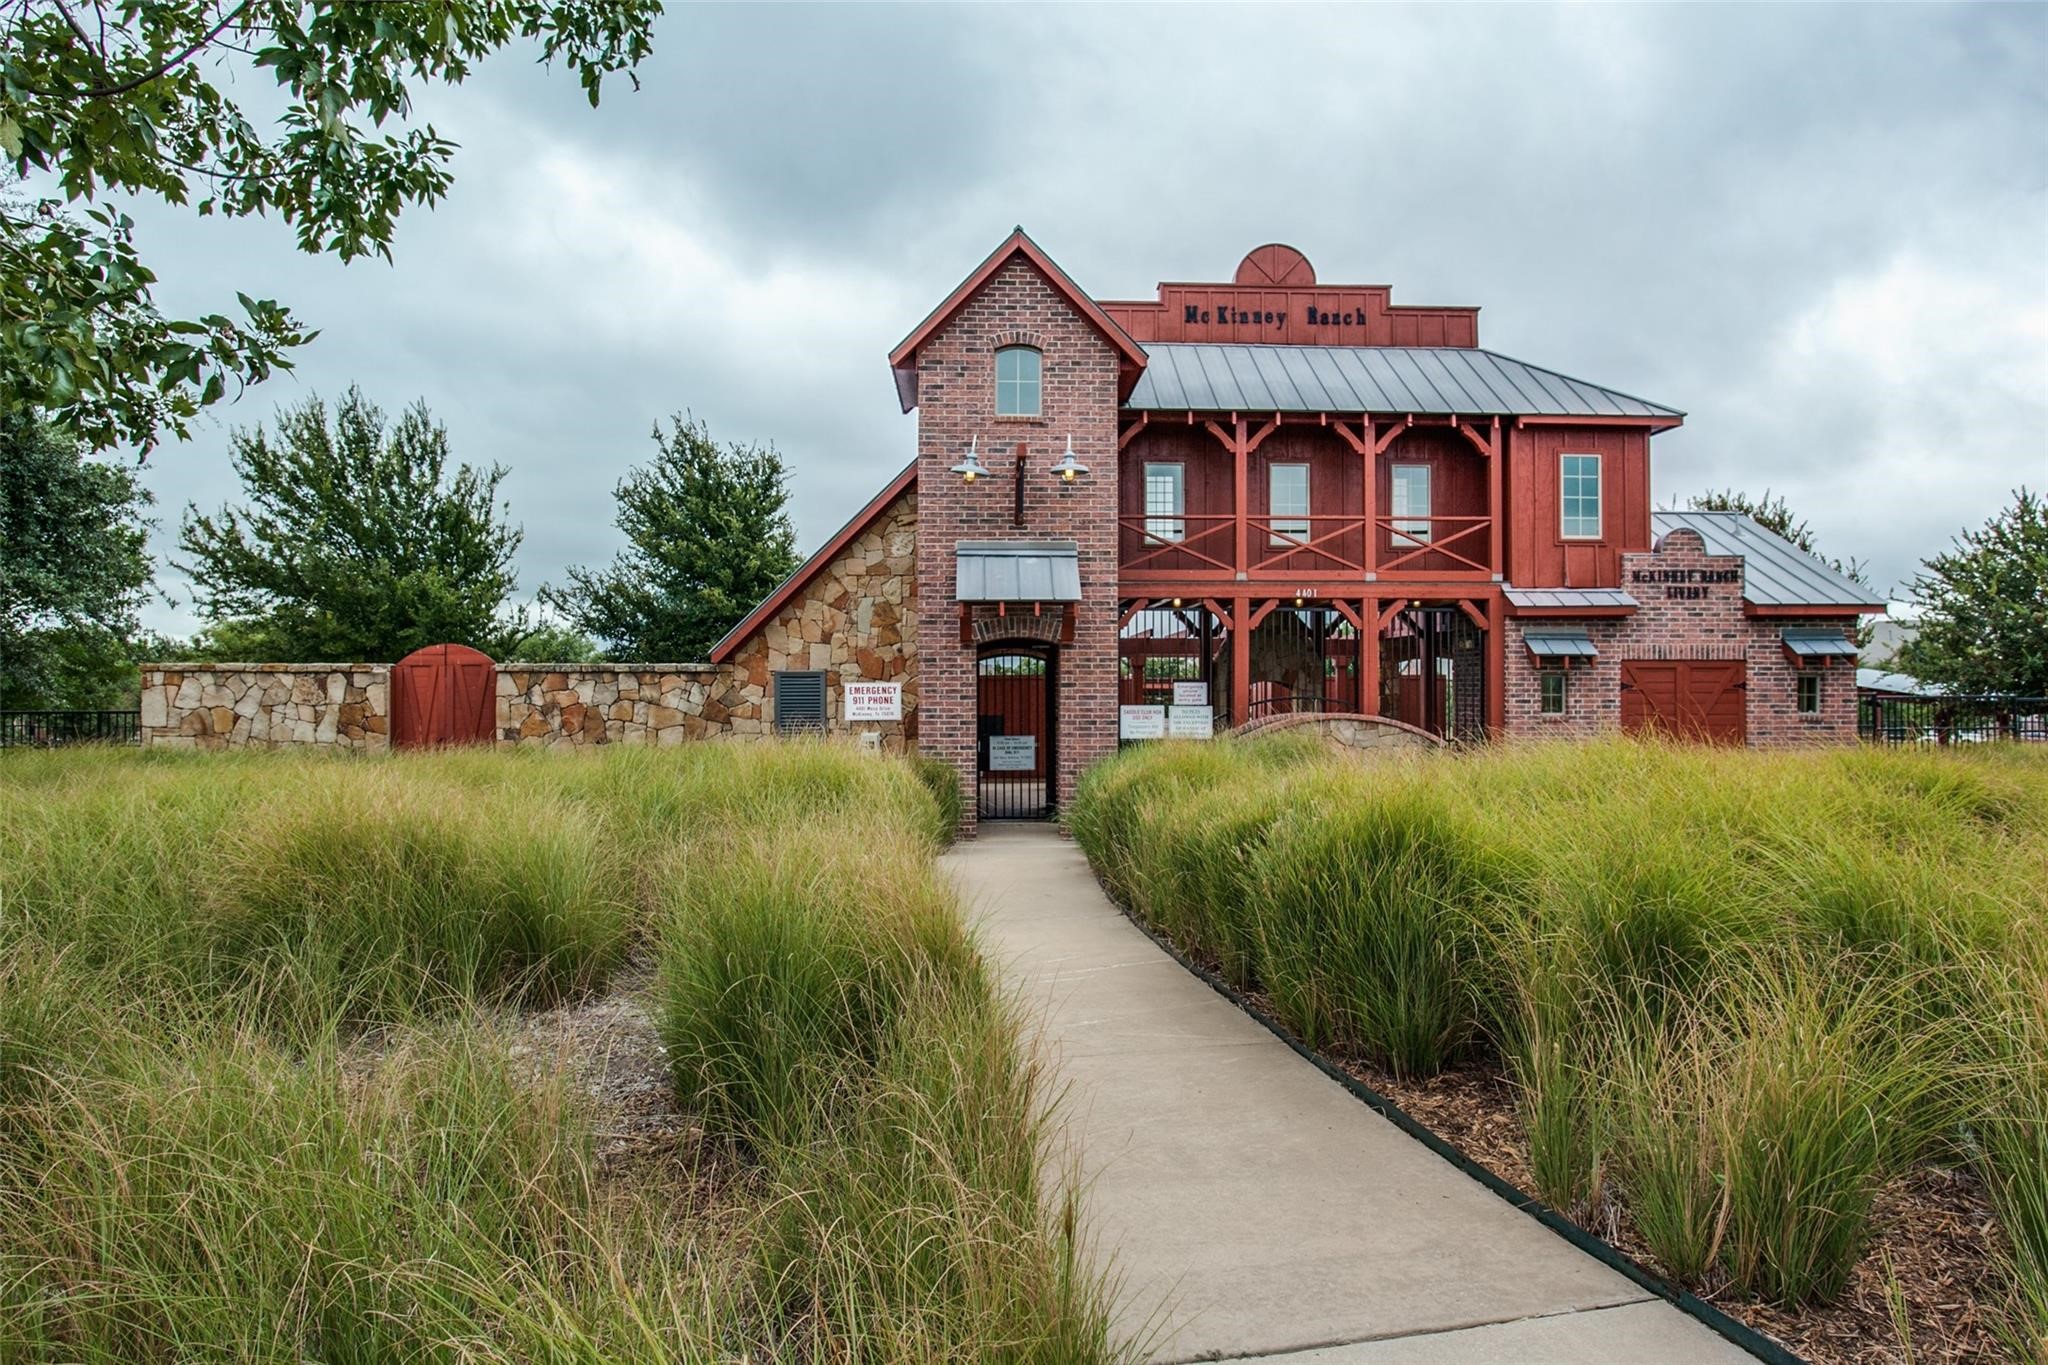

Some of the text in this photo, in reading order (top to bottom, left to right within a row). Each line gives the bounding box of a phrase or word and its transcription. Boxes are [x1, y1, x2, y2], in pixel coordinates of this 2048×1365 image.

[1307, 306, 1367, 325] Ranch
[1700, 570, 1739, 584] RANCH
[1295, 588, 1317, 598] 4401
[1666, 586, 1709, 600] LIVERY
[849, 686, 897, 695] EMERGENCY
[852, 696, 894, 705] 911 PHONE
